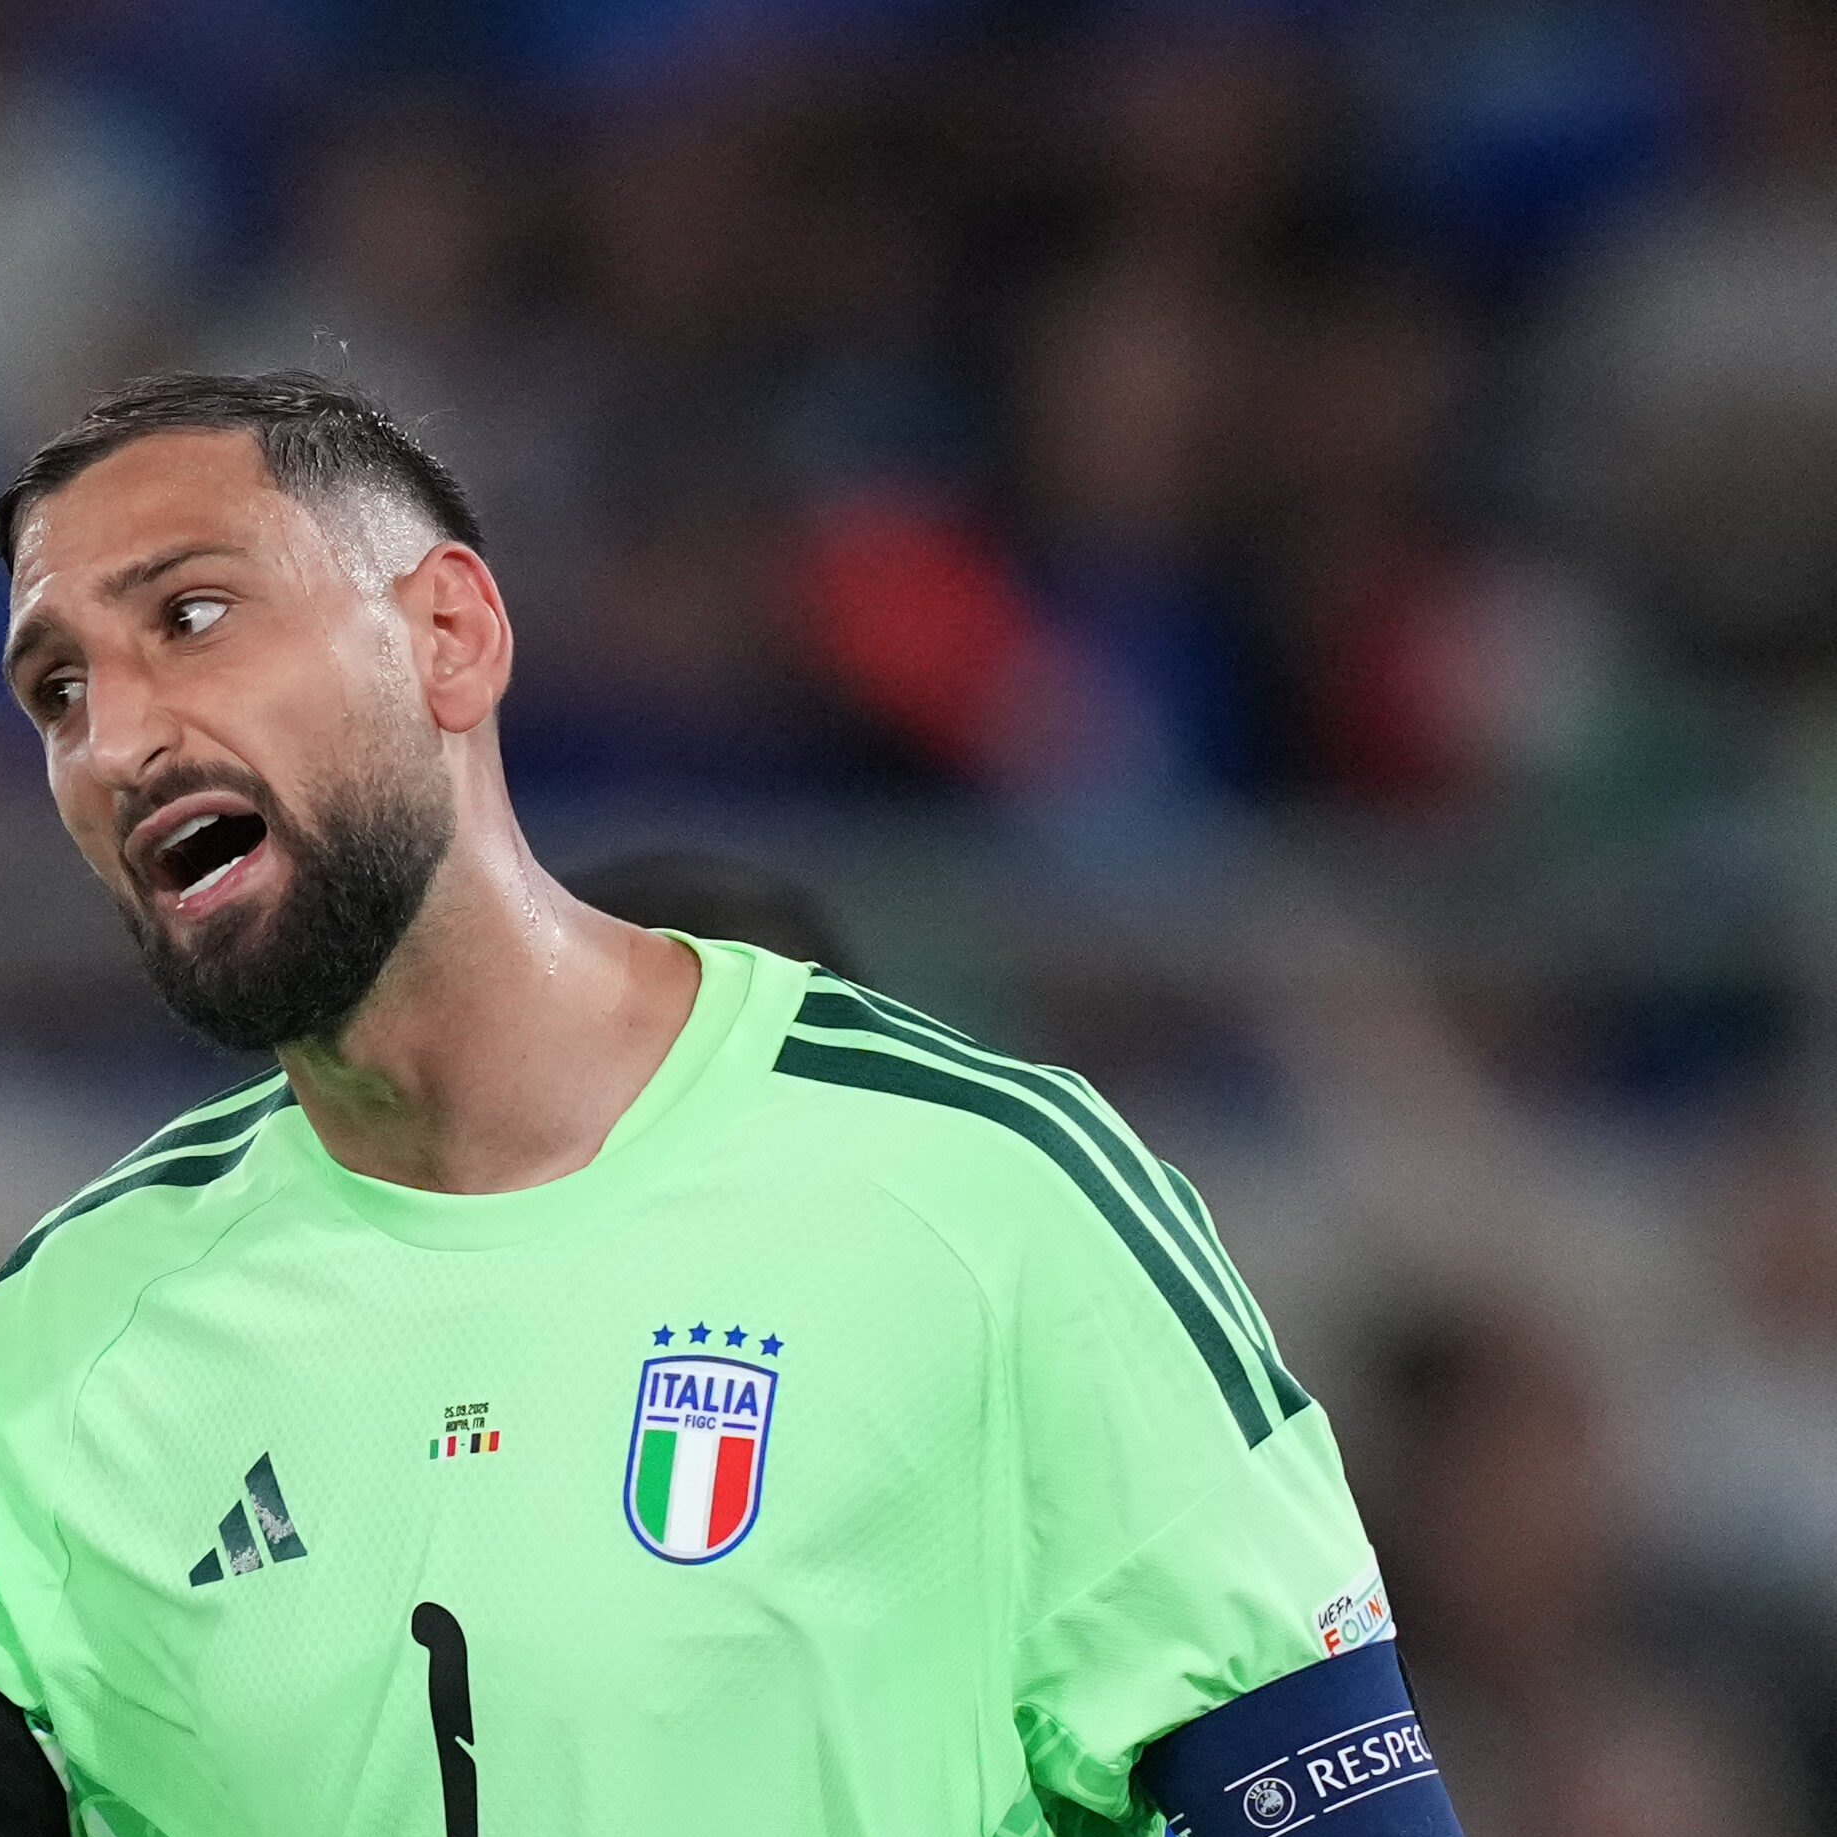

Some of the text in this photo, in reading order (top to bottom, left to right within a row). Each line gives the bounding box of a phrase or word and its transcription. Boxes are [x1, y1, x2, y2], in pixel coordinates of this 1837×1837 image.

[648, 1372, 759, 1417] ITALIA
[684, 1414, 717, 1430] FIGC
[1318, 1595, 1354, 1630] UEFA
[1324, 1588, 1386, 1657] FOUN
[1249, 1781, 1277, 1800] UEFA
